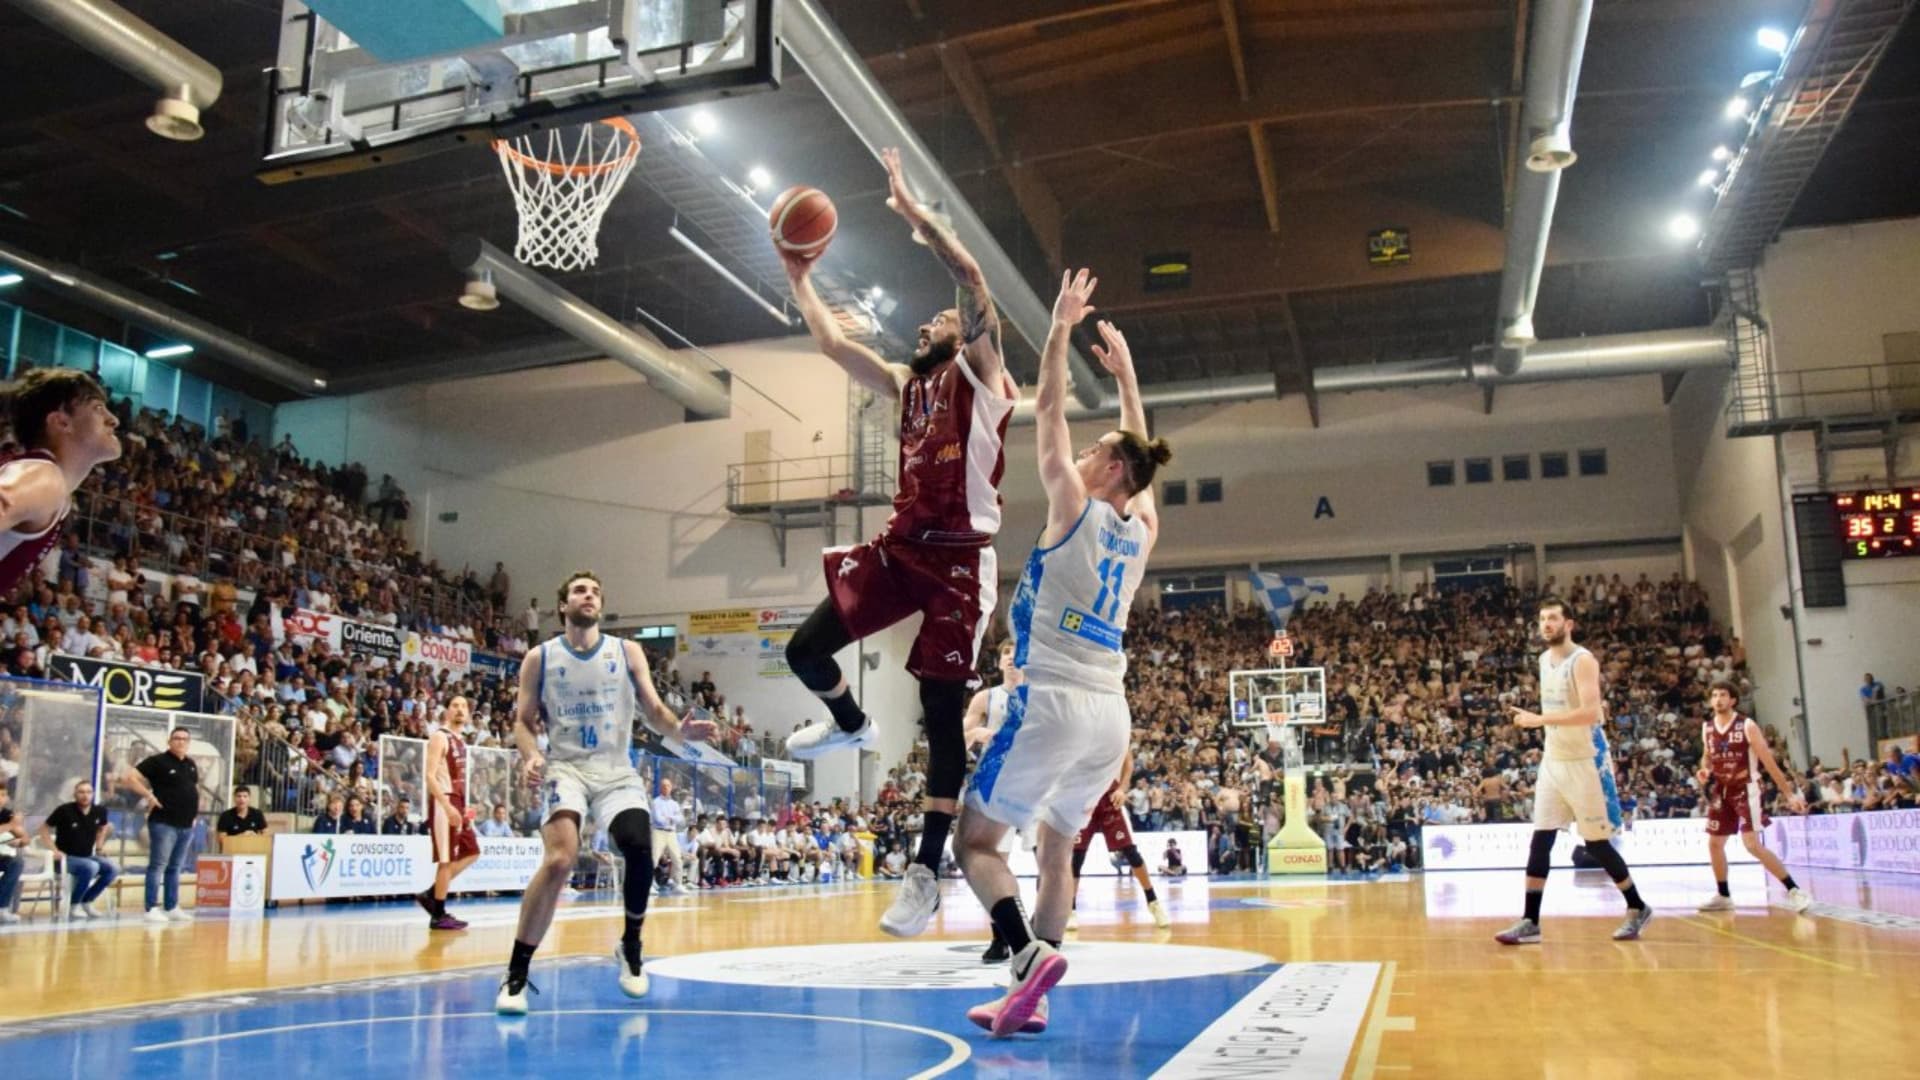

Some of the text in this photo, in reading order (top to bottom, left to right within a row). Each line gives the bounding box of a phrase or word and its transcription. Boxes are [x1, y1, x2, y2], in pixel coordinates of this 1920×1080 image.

[1313, 496, 1335, 519] A
[1848, 517, 1874, 537] 35
[1883, 518, 1894, 533] 2
[1091, 556, 1126, 622] 11
[343, 623, 394, 648] Oriente
[420, 641, 468, 664] CONAD
[579, 724, 598, 749] 14
[1728, 730, 1744, 744] 19
[350, 843, 405, 855] CONSORZIO
[1283, 855, 1322, 864] CONAD
[339, 857, 412, 878] LE QUOTE
